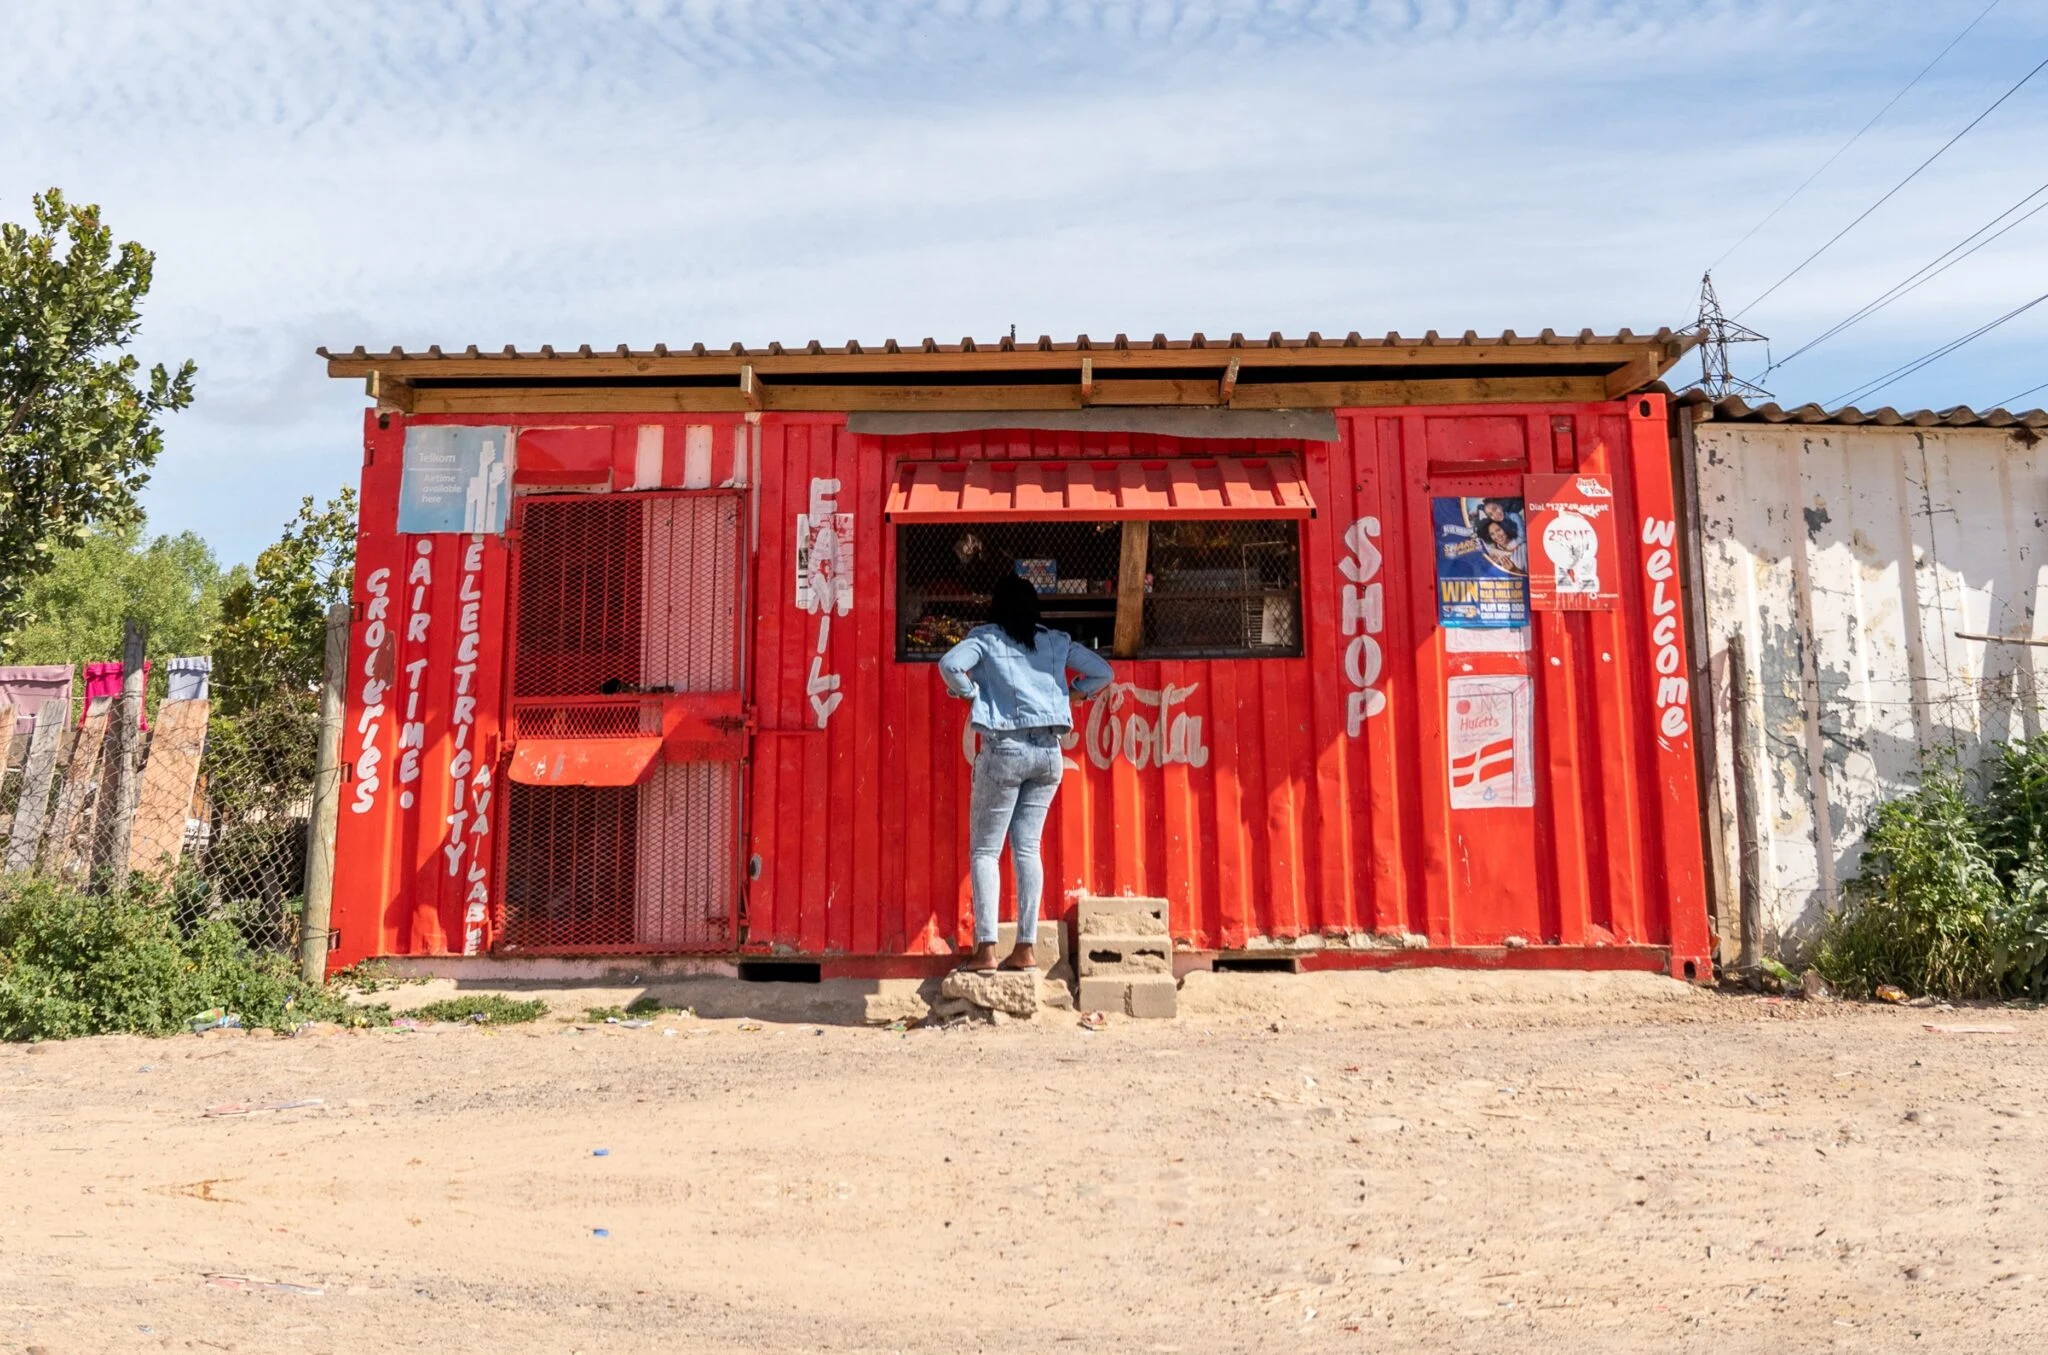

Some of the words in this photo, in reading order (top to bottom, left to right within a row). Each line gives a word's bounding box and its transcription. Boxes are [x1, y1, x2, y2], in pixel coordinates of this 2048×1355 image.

[418, 452, 456, 463] Telkom
[424, 473, 457, 483] Airtime
[422, 484, 462, 493] available
[421, 494, 442, 504] here
[1441, 581, 1479, 602] WIN
[1338, 515, 1387, 738] SHOP
[443, 544, 485, 877] ELECTRICITY
